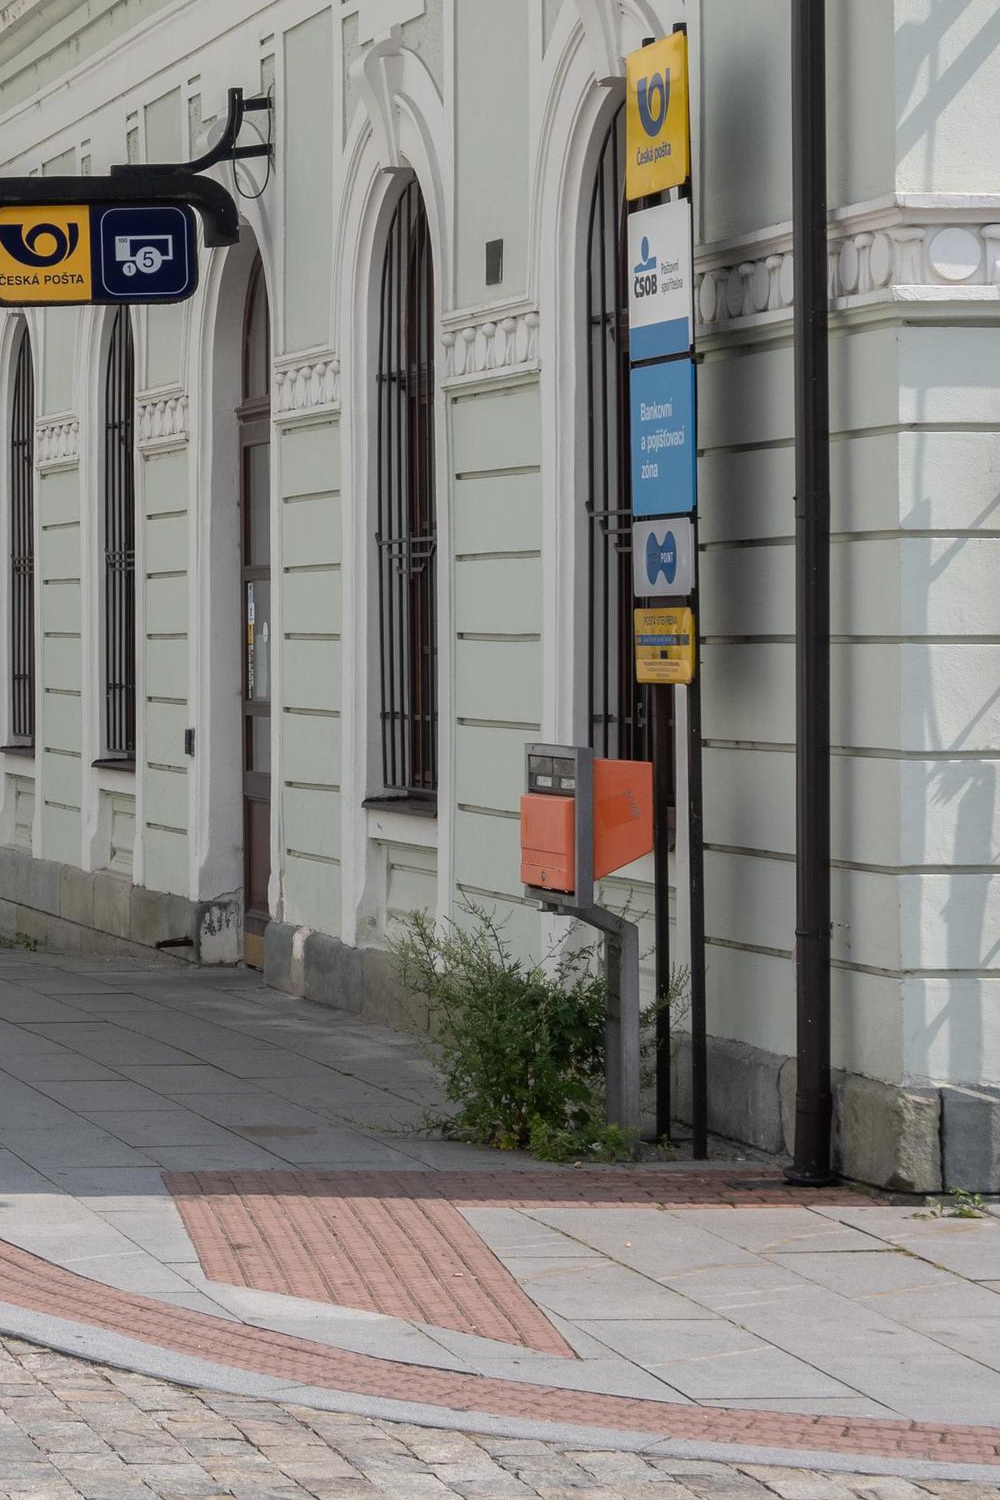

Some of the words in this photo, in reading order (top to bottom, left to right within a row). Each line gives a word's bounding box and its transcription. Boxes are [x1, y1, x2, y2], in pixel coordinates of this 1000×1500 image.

[637, 147, 654, 165] Česká
[655, 142, 671, 163] pošta
[126, 264, 132, 274] 1
[142, 251, 154, 268] 5
[44, 272, 84, 285] POŠTA
[634, 274, 657, 299] ČSOB
[640, 397, 672, 421] Bankovní
[641, 436, 646, 450] a
[647, 425, 685, 453] pojišťovací
[641, 460, 658, 479] zóna
[660, 551, 674, 564] POINT
